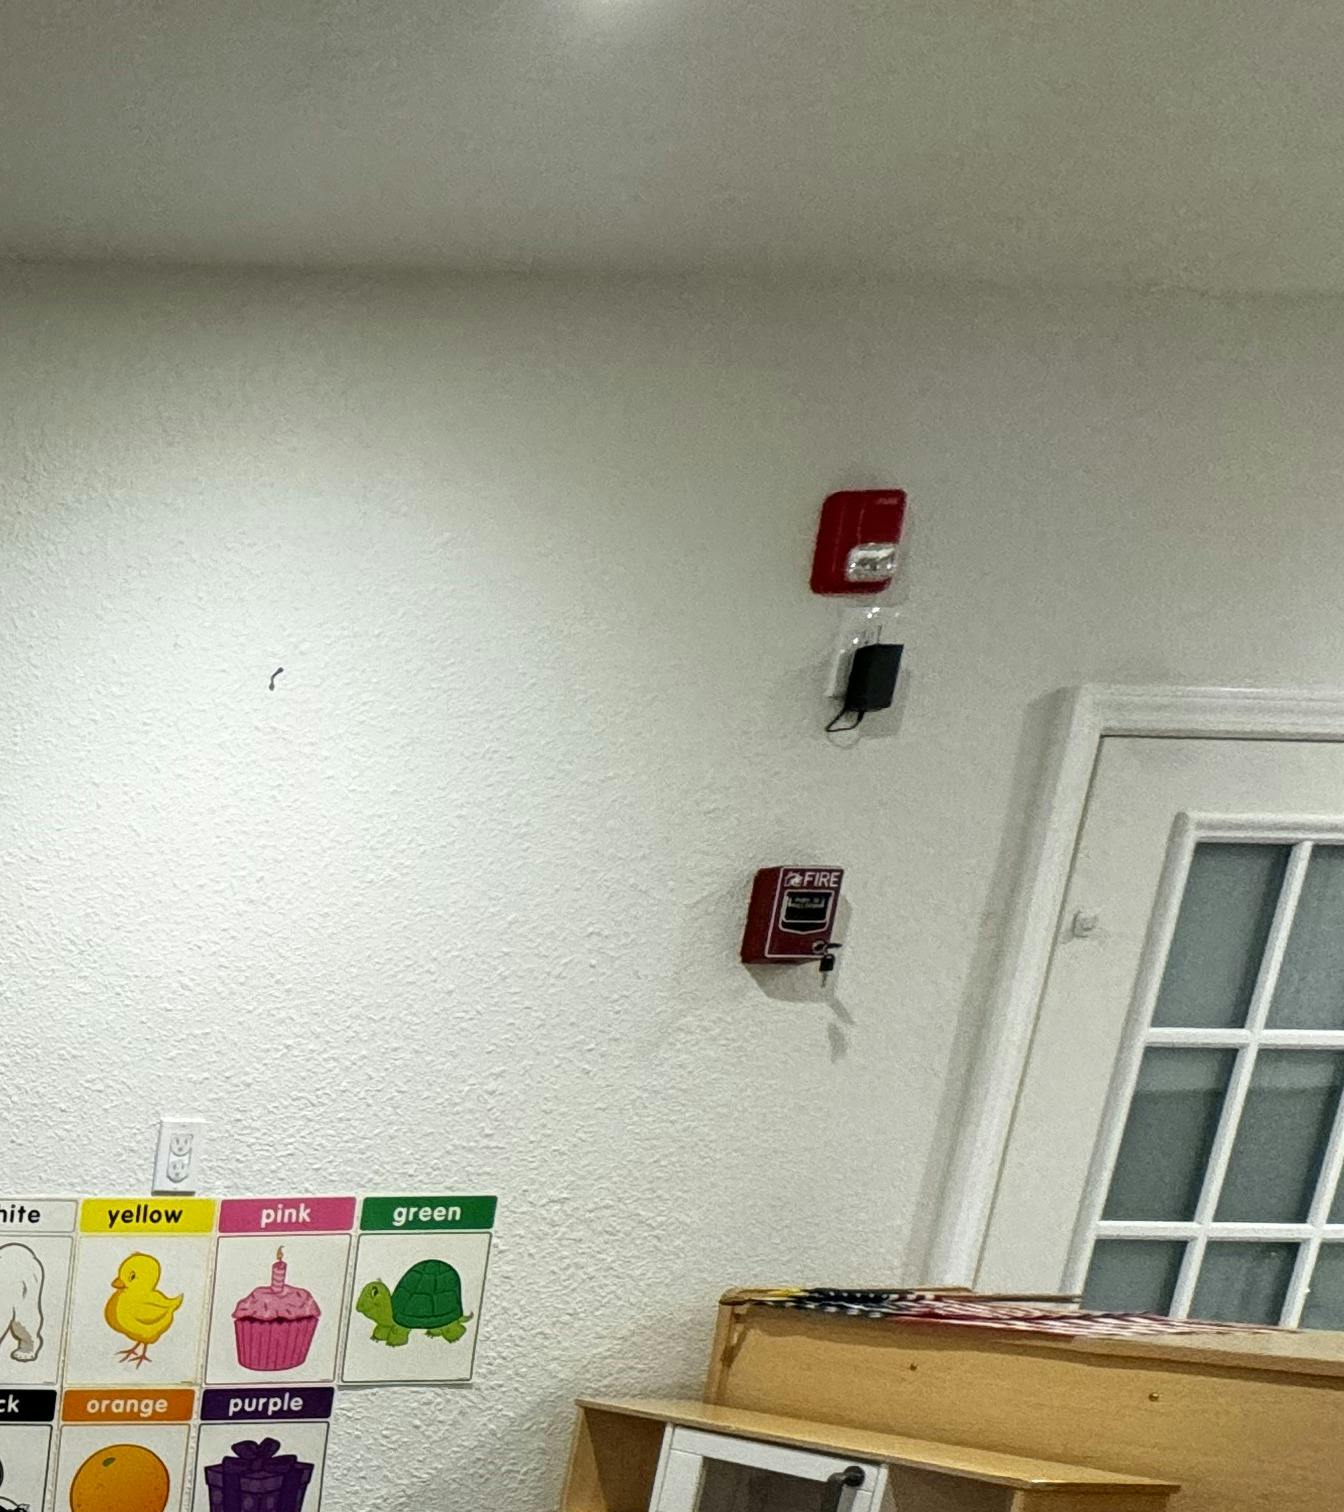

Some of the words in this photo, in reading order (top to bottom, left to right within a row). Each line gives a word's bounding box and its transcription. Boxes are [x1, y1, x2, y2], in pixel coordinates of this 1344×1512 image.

[803, 872, 841, 887] FIRE
[107, 1204, 183, 1229] yellow
[261, 1204, 311, 1225] pink
[393, 1204, 461, 1227] green
[86, 1397, 168, 1418] orange
[229, 1393, 303, 1417] purple
